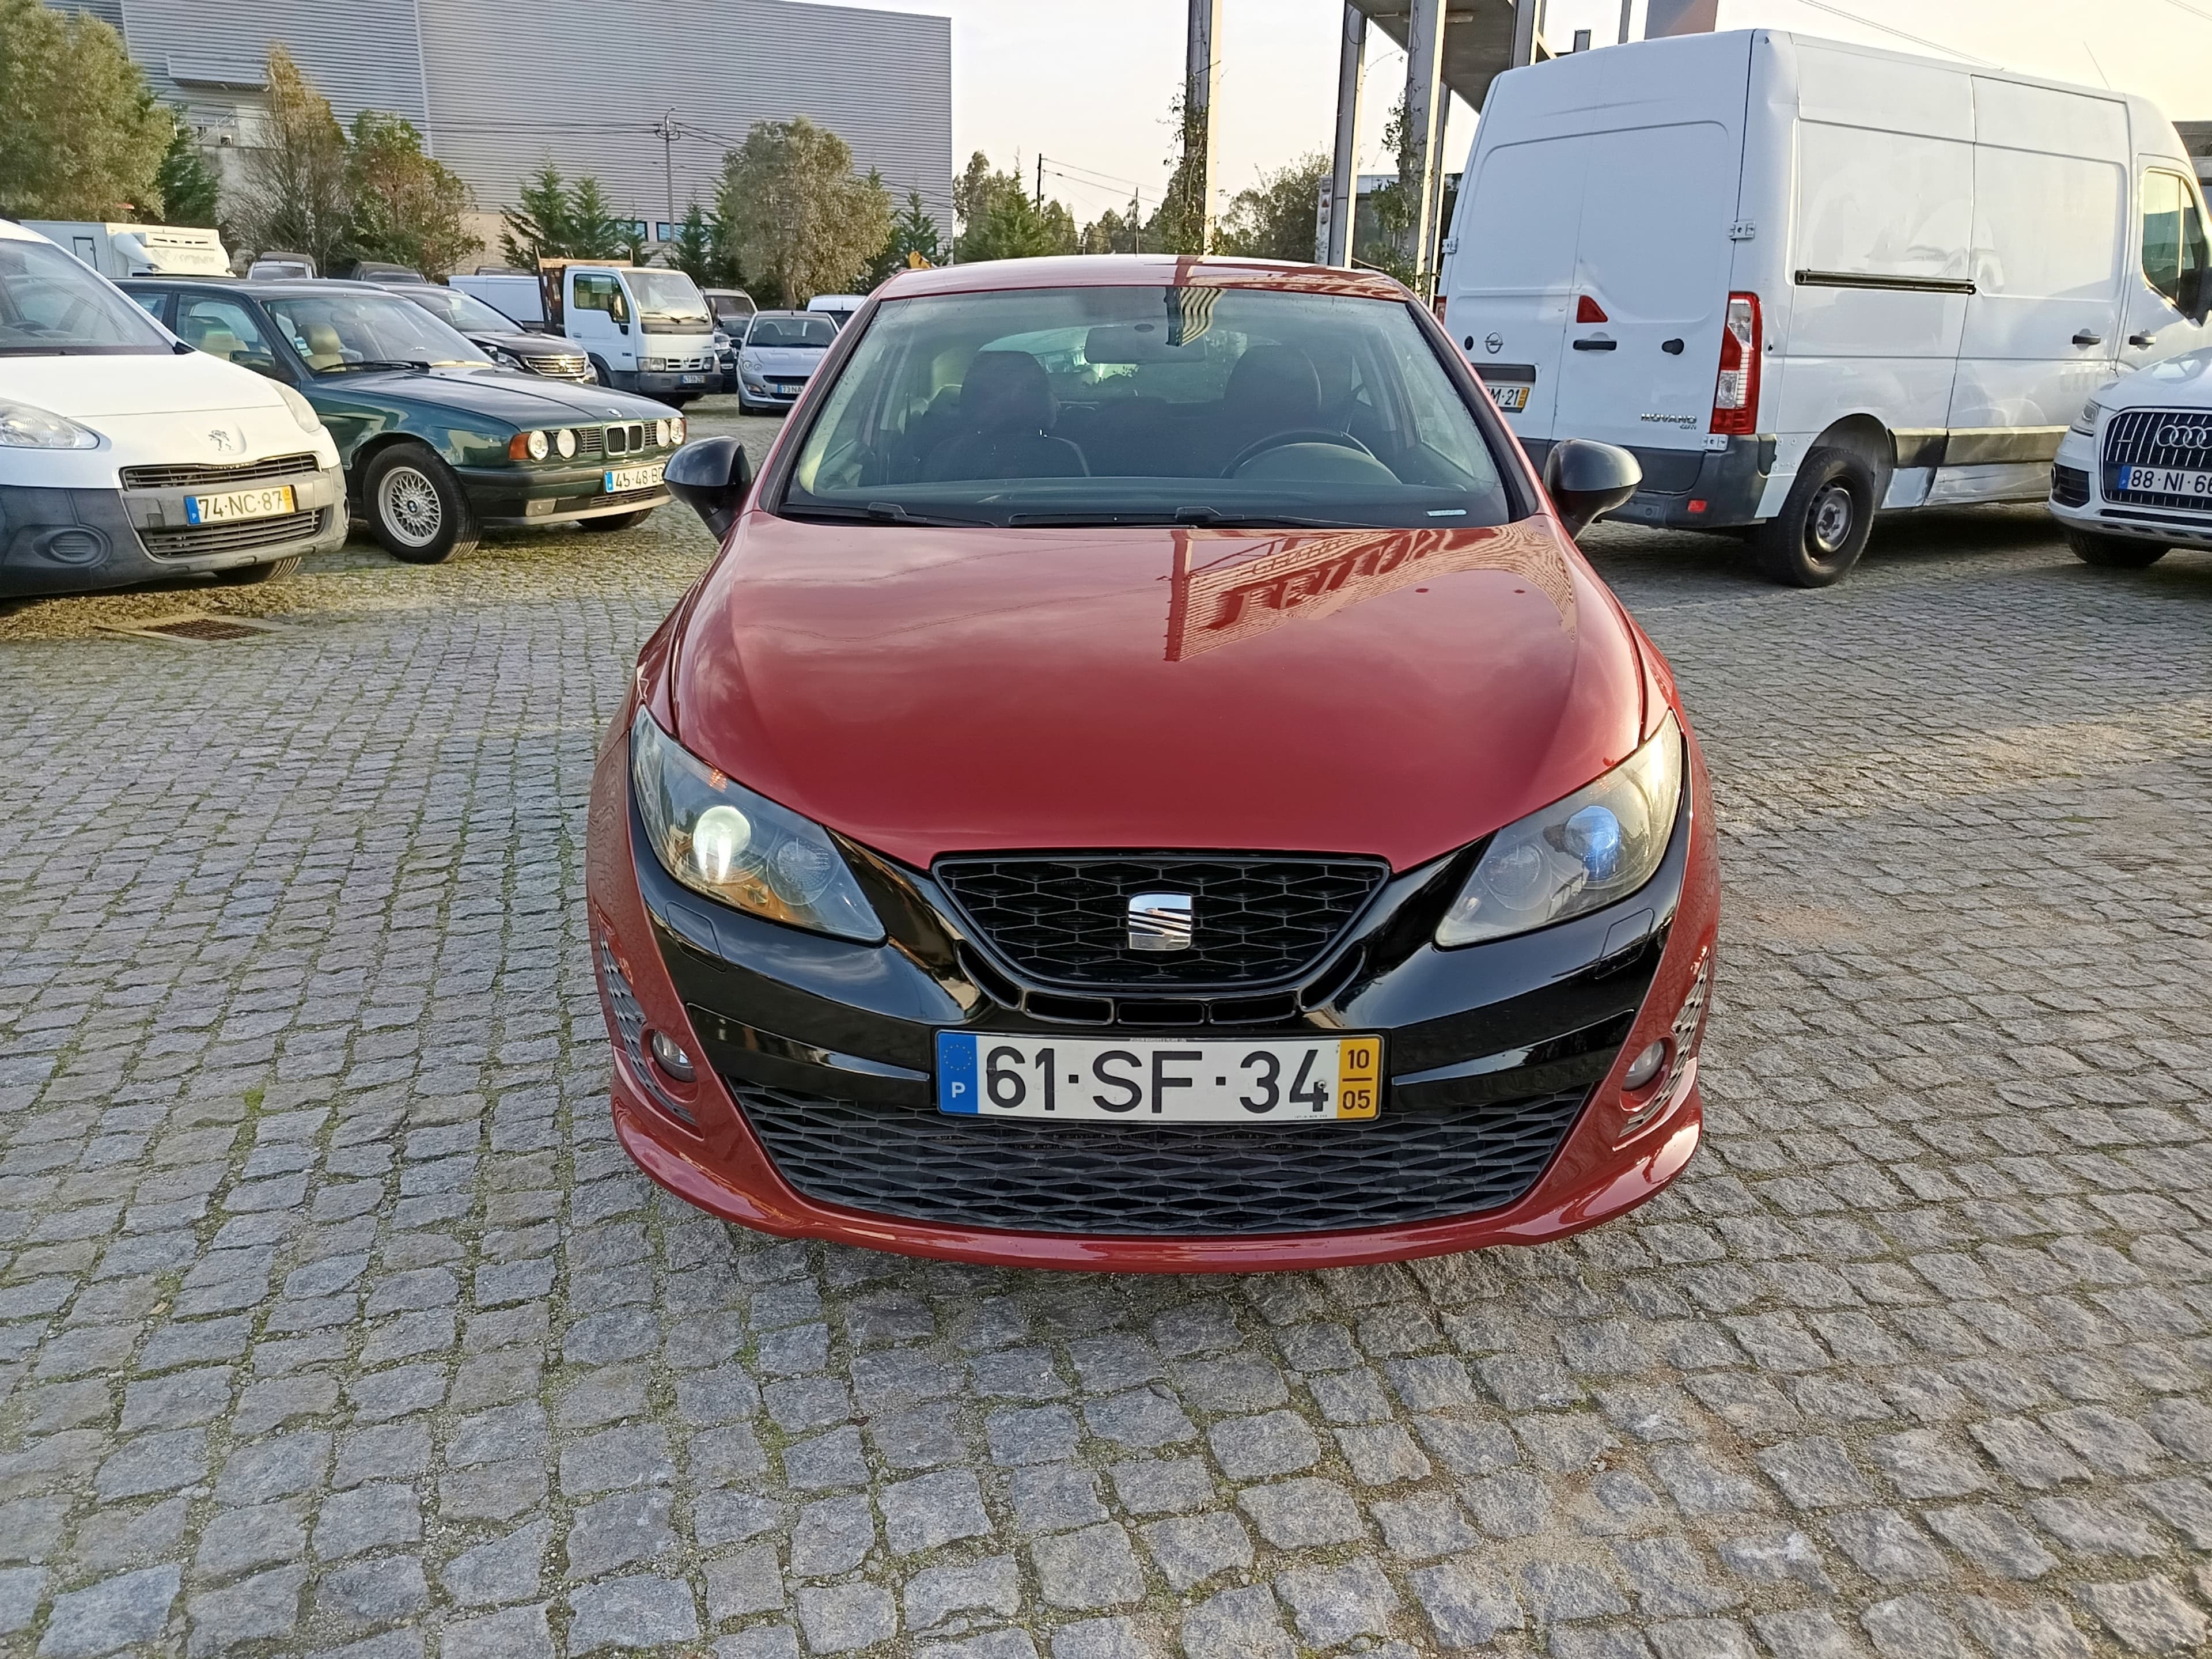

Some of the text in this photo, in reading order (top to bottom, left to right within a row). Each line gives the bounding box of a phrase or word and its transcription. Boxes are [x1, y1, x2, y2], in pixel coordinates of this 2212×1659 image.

[1487, 388, 1520, 406] M·21
[1641, 413, 1697, 424] MOVANO
[1347, 1048, 1370, 1070] 10
[951, 1081, 966, 1099] P
[1342, 1089, 1371, 1110] 05
